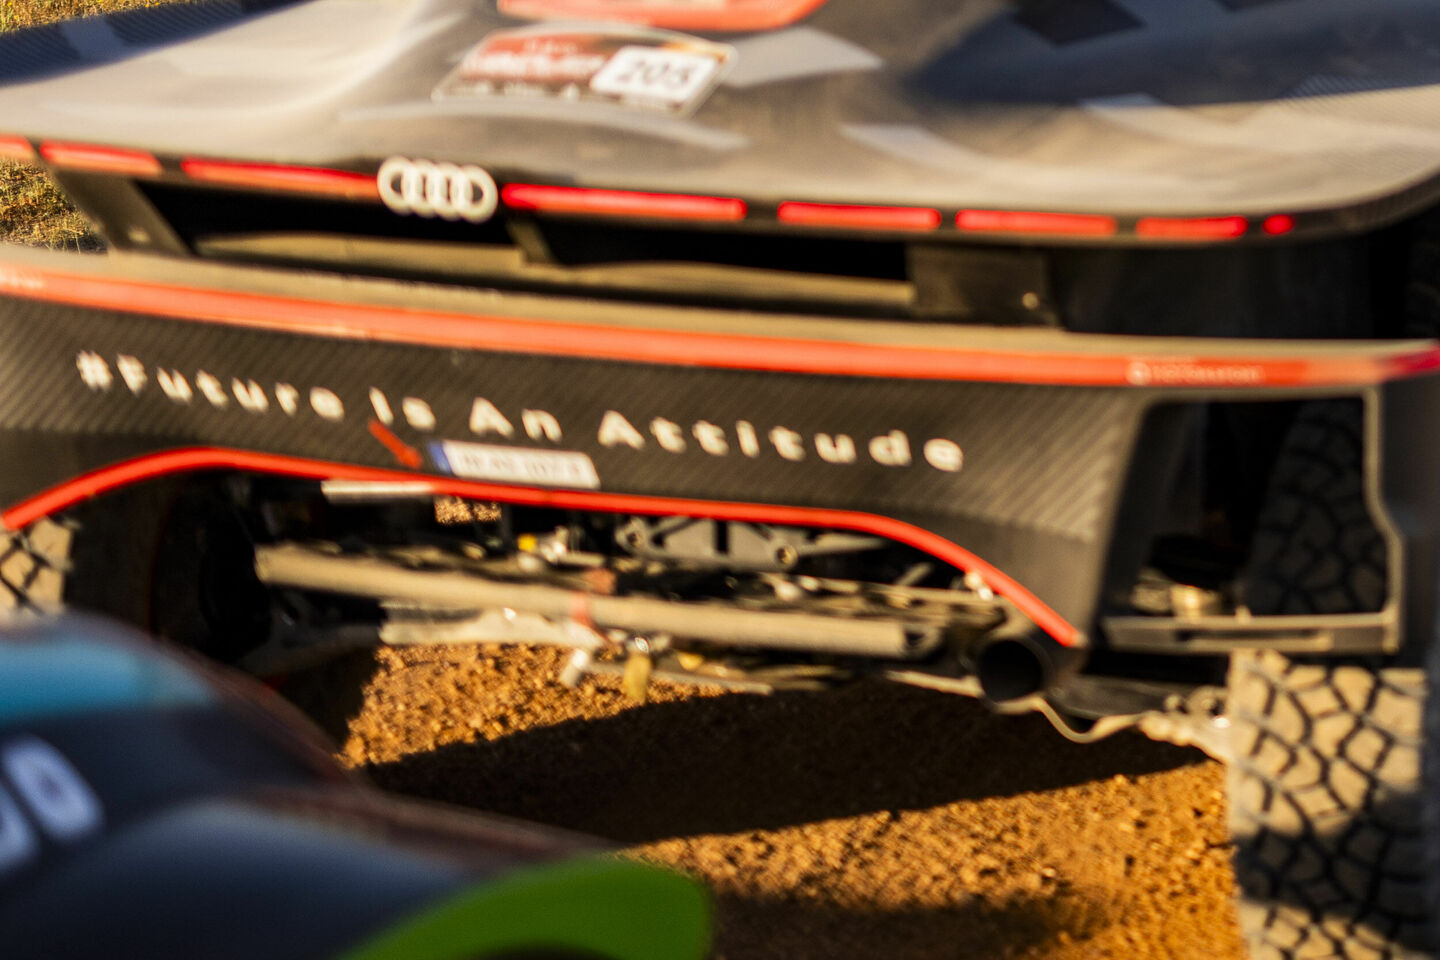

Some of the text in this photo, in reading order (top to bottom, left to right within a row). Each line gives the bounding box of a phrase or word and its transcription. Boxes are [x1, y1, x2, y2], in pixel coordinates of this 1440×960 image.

[76, 351, 345, 421] #Future
[468, 396, 564, 440] An
[597, 409, 964, 473] Attitude
